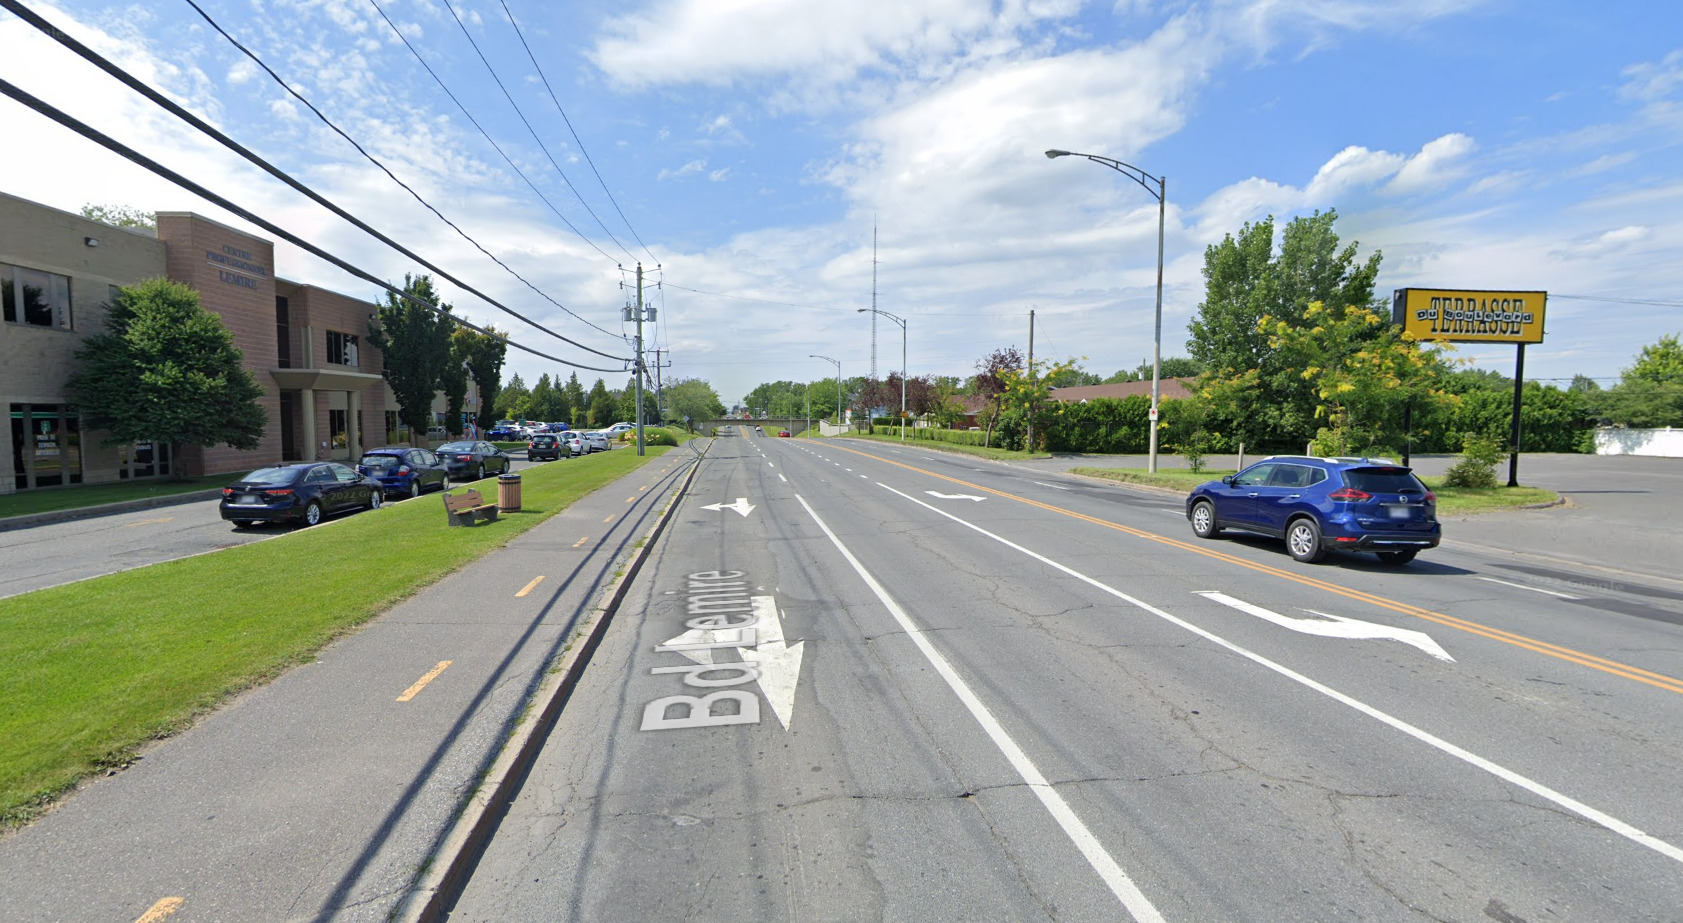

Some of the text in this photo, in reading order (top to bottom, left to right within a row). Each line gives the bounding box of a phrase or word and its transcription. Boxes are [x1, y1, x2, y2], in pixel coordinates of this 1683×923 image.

[222, 244, 253, 261] CENTRE
[219, 270, 258, 290] LEMIRE
[1431, 296, 1524, 336] TERRASSE
